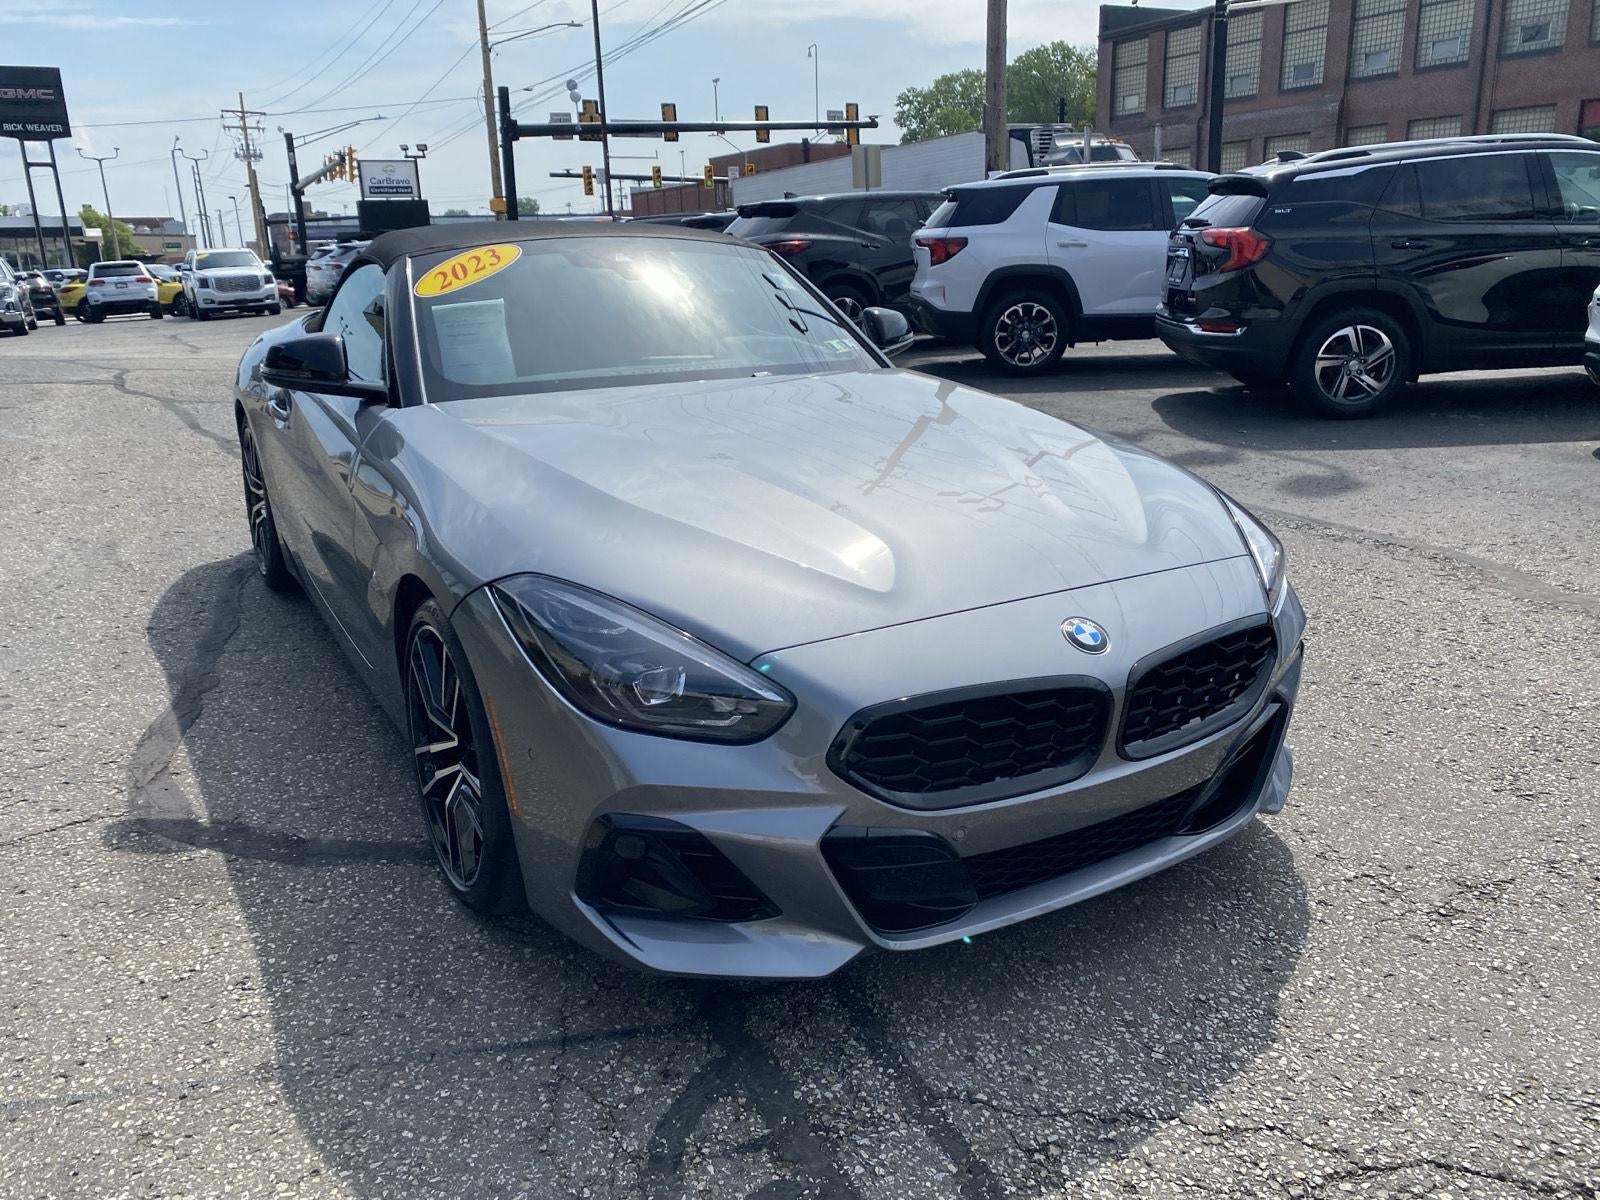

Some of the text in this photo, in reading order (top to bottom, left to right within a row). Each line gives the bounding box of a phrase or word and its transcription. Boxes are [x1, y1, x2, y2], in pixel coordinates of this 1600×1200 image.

[0, 88, 55, 100] GMC
[2, 123, 63, 132] RICK WEAVER
[369, 177, 411, 185] CarBravo
[433, 248, 502, 291] 2023
